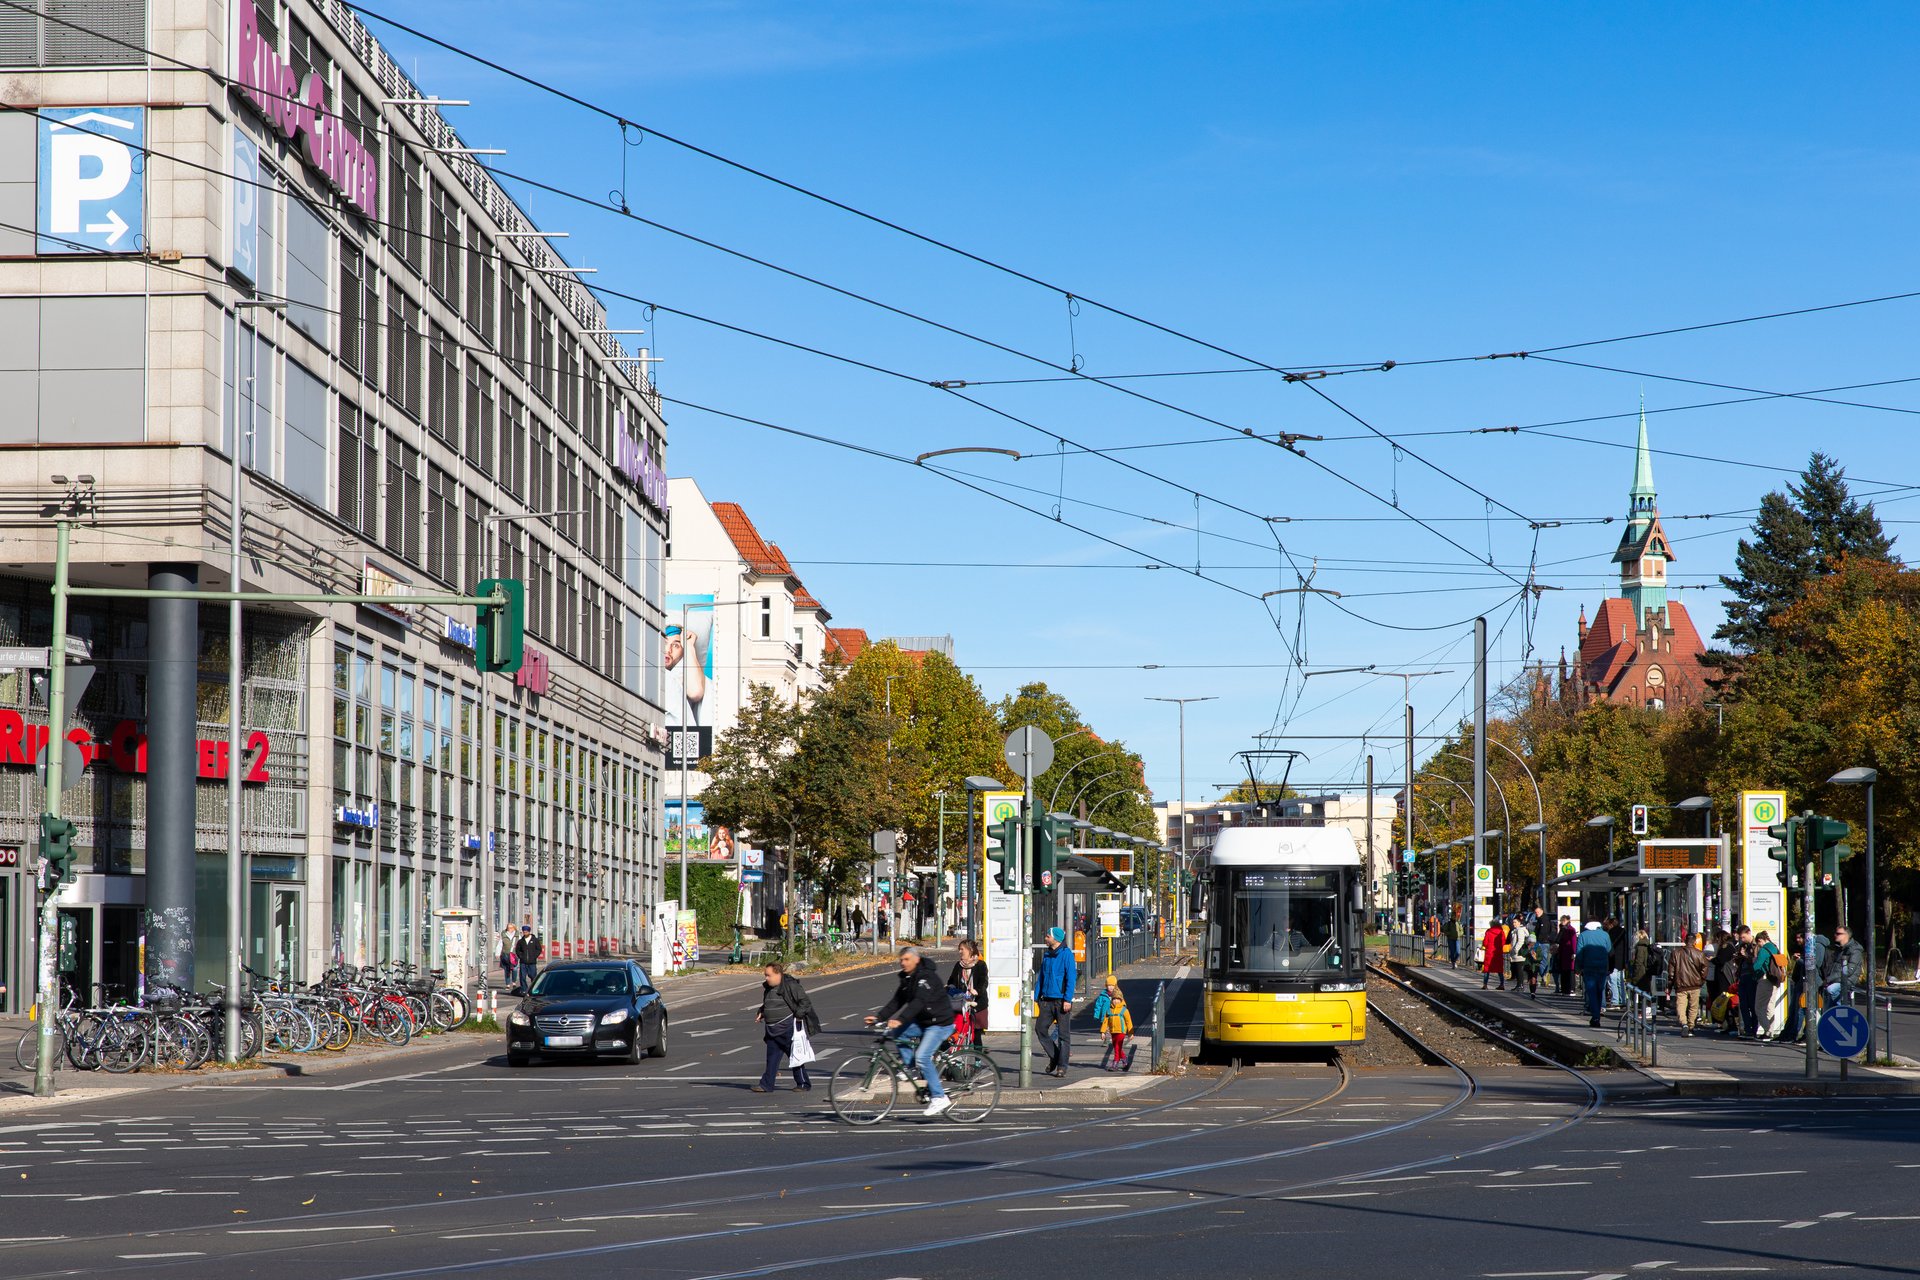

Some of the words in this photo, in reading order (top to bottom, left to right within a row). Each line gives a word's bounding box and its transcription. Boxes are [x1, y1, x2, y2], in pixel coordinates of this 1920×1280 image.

[51, 134, 132, 233] P
[18, 651, 40, 662] Allee
[247, 731, 270, 783] 2
[1000, 807, 1009, 817] H
[1759, 806, 1770, 818] H
